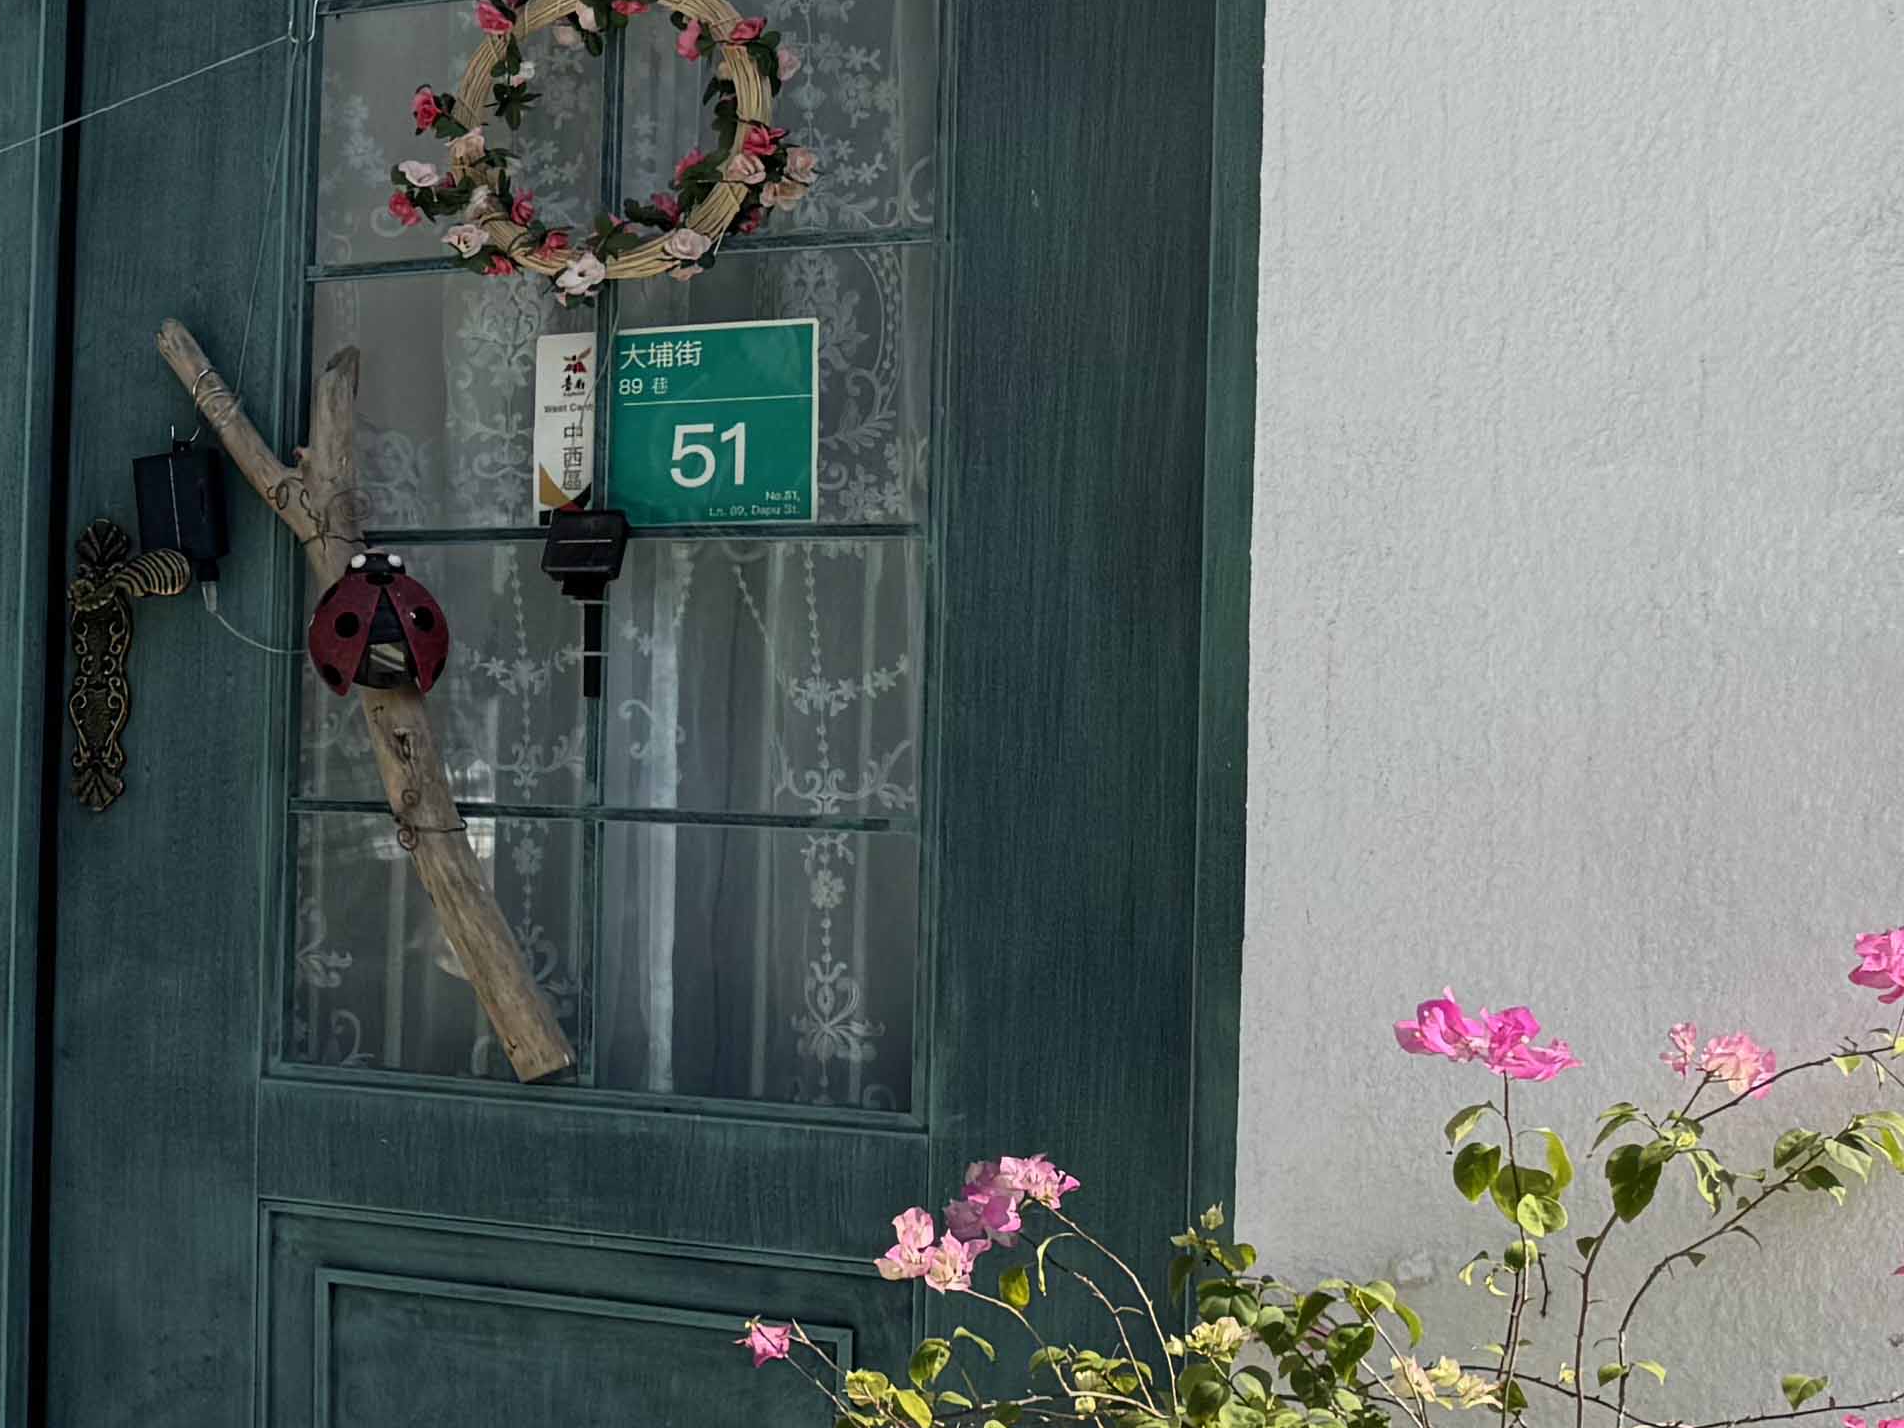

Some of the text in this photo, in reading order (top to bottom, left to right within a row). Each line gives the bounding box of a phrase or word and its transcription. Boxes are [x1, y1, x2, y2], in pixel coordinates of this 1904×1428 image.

[619, 340, 702, 370] 大埔街
[619, 376, 668, 396] 89 巷
[562, 422, 584, 490] 中西區
[669, 422, 747, 488] 51
